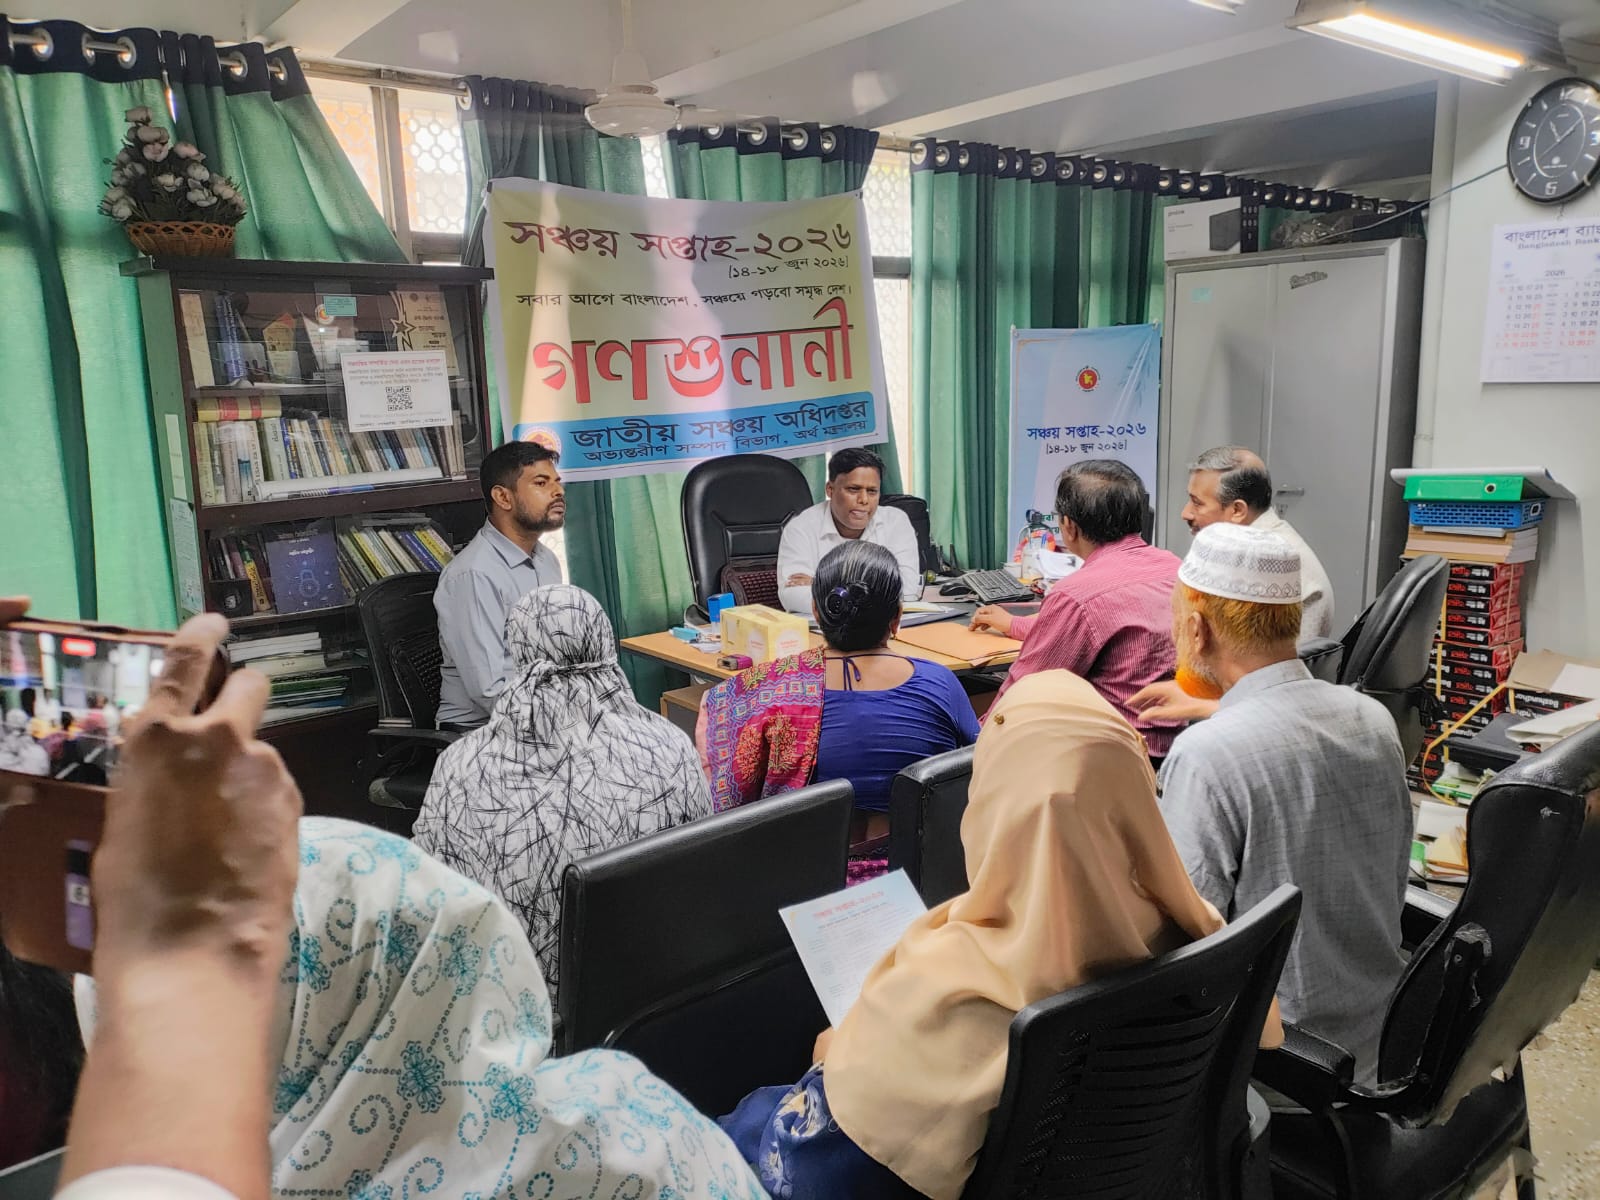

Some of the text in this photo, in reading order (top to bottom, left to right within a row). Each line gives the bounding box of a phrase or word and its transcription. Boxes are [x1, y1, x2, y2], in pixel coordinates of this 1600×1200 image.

[1518, 136, 1531, 149] 9
[1545, 181, 1558, 195] 6
[503, 221, 851, 262] সঞ্চয় সপ্তাহ-২০২৬
[784, 258, 808, 270] জুন
[516, 293, 563, 307] সবার
[568, 292, 615, 306] আগে
[751, 286, 791, 301] গড়বো
[532, 297, 854, 404] গণশুনানী
[568, 400, 868, 448] জাতীয় সঞ্চয় অধিদপ্তর
[793, 425, 818, 440] অর্থ
[1026, 423, 1147, 440] সঞ্চয় সপ্তাহ-২০২৬
